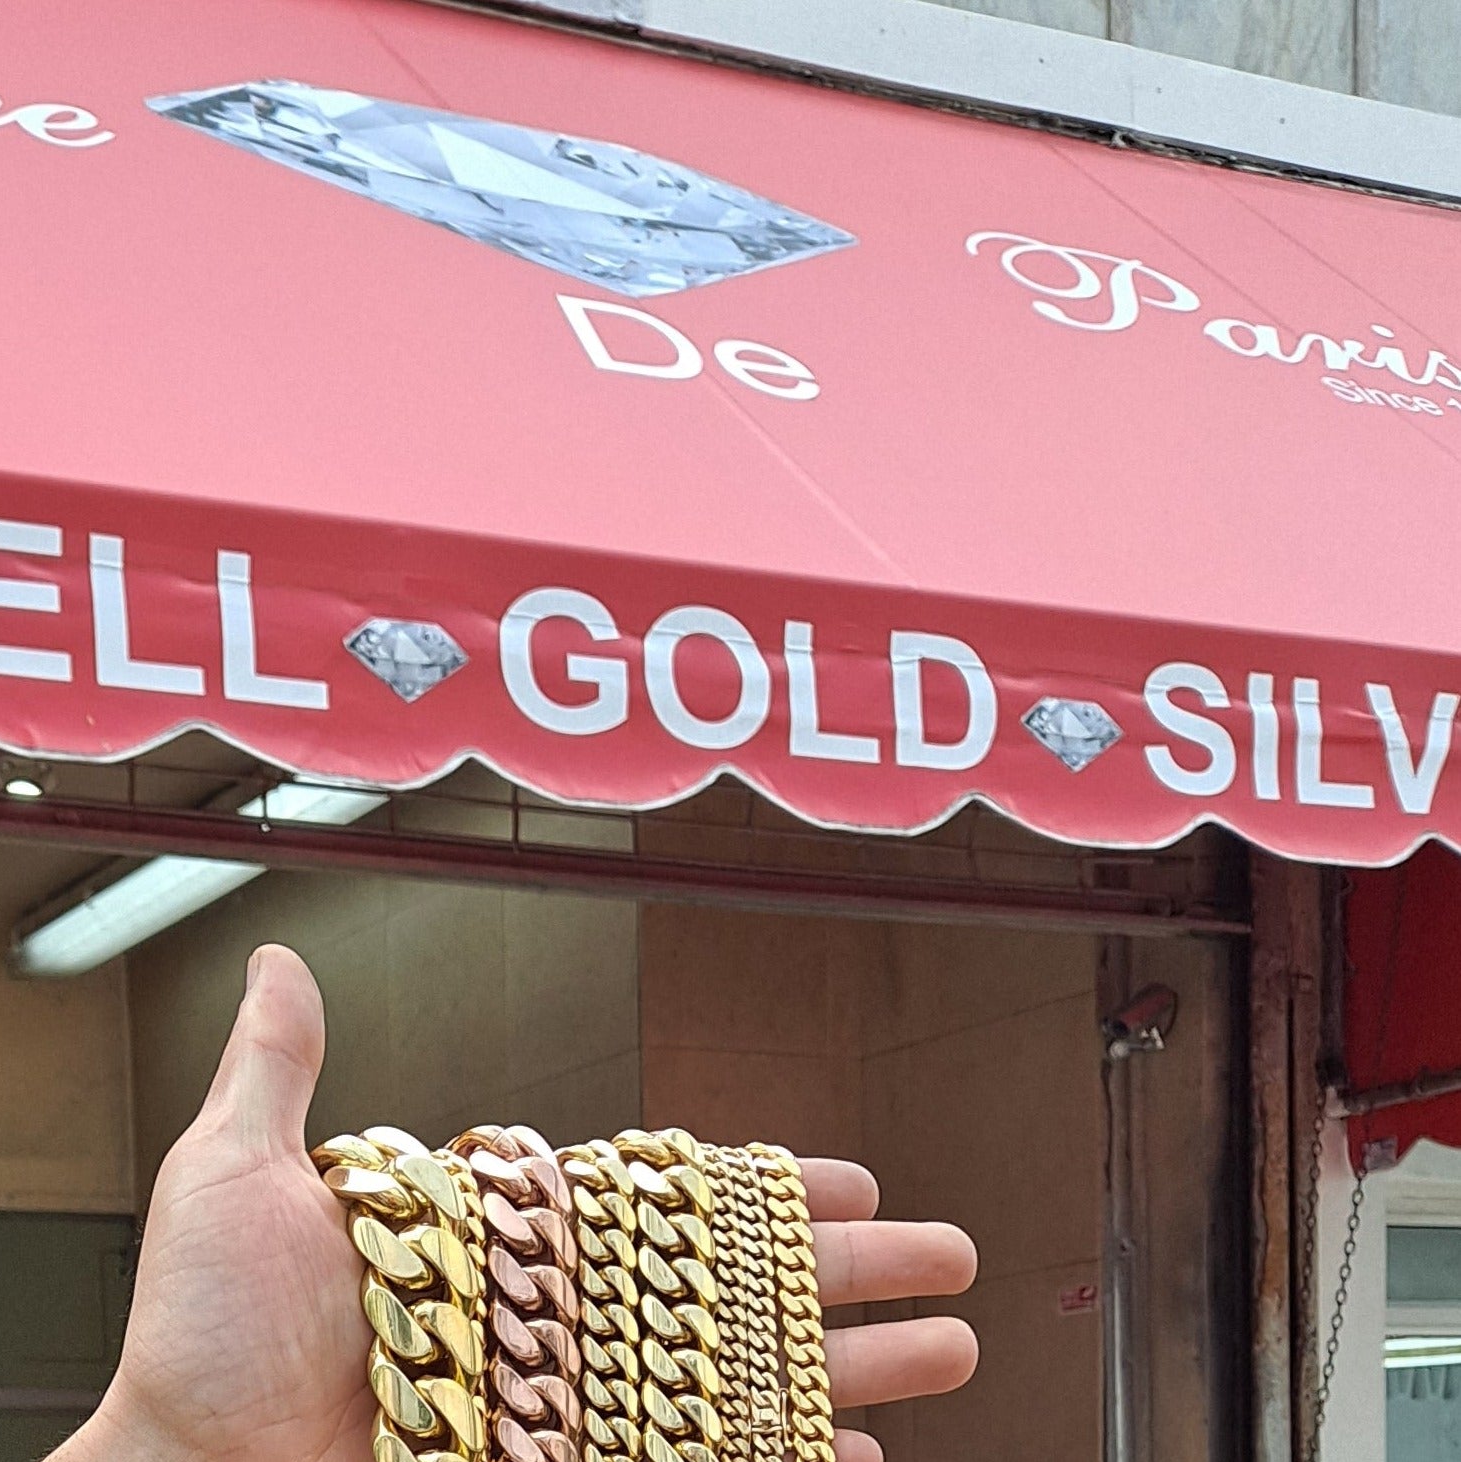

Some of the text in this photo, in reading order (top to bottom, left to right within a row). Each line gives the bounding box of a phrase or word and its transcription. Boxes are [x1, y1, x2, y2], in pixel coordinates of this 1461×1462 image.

[555, 293, 821, 402] De
[965, 231, 1461, 392] Paris
[1320, 376, 1445, 416] Since
[498, 586, 998, 771] GOLD
[1142, 660, 1461, 815] SILV
